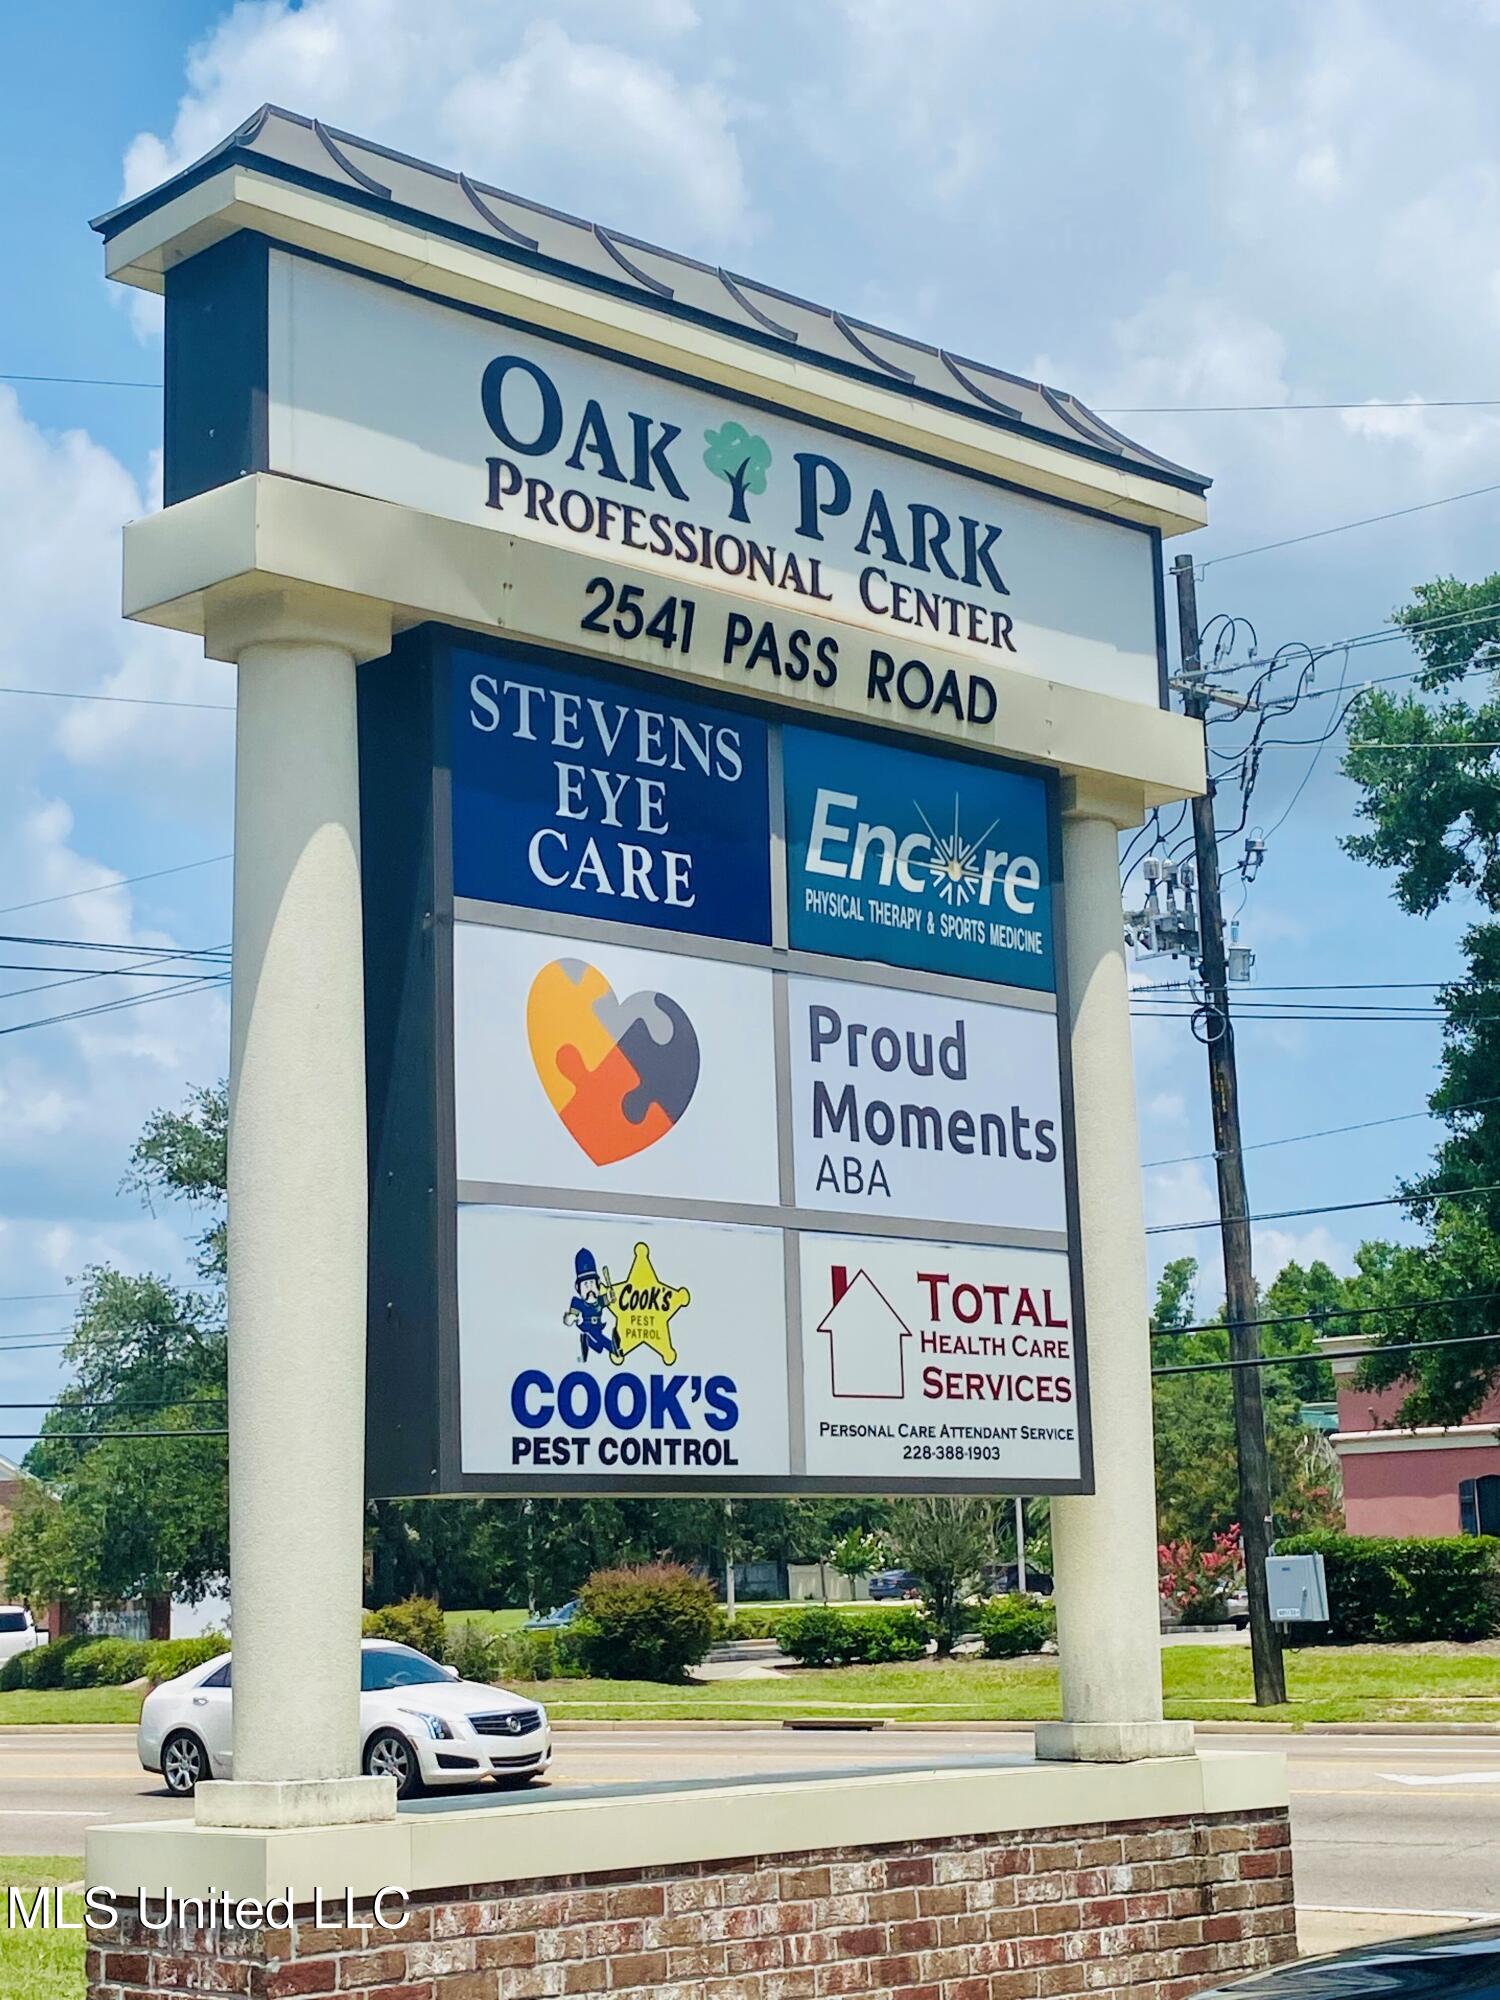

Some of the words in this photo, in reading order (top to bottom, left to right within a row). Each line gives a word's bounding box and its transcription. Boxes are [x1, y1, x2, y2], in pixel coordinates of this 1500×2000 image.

[481, 355, 690, 501] OAK
[794, 453, 1010, 596] PARK
[485, 457, 832, 601] PROFESSIONAL
[859, 566, 1017, 652] CENTER
[581, 577, 695, 654] 2541
[724, 613, 838, 688] PASS
[868, 650, 997, 724] ROAD
[469, 674, 743, 782] STEVENS
[554, 761, 669, 836] EYE
[528, 829, 696, 908] CARE
[806, 888, 864, 921] PHYSICAL
[868, 899, 921, 931] THERAPY
[927, 911, 935, 935] &
[940, 914, 984, 944] SPORTS
[990, 924, 1043, 954] MEDICINE
[810, 1004, 967, 1081] Proud
[812, 1080, 1057, 1163] Moments
[815, 1154, 891, 1198] ABA
[631, 1315, 654, 1326] PEST
[917, 1271, 1068, 1329] TOTAL
[626, 1329, 661, 1340] PATROL
[921, 1330, 1006, 1356] HEALTH
[1012, 1335, 1070, 1358] CARE
[511, 1369, 739, 1433] COOK'S
[923, 1366, 1072, 1402] SERVICES
[512, 1438, 587, 1466] PEST
[599, 1438, 739, 1466] CONTROL
[819, 1422, 894, 1437] PERSONAL
[898, 1424, 936, 1438] CARE
[940, 1424, 1017, 1439] ATTENDANT
[1021, 1426, 1074, 1440] SERVICE
[903, 1446, 1000, 1460] 228-388-1903
